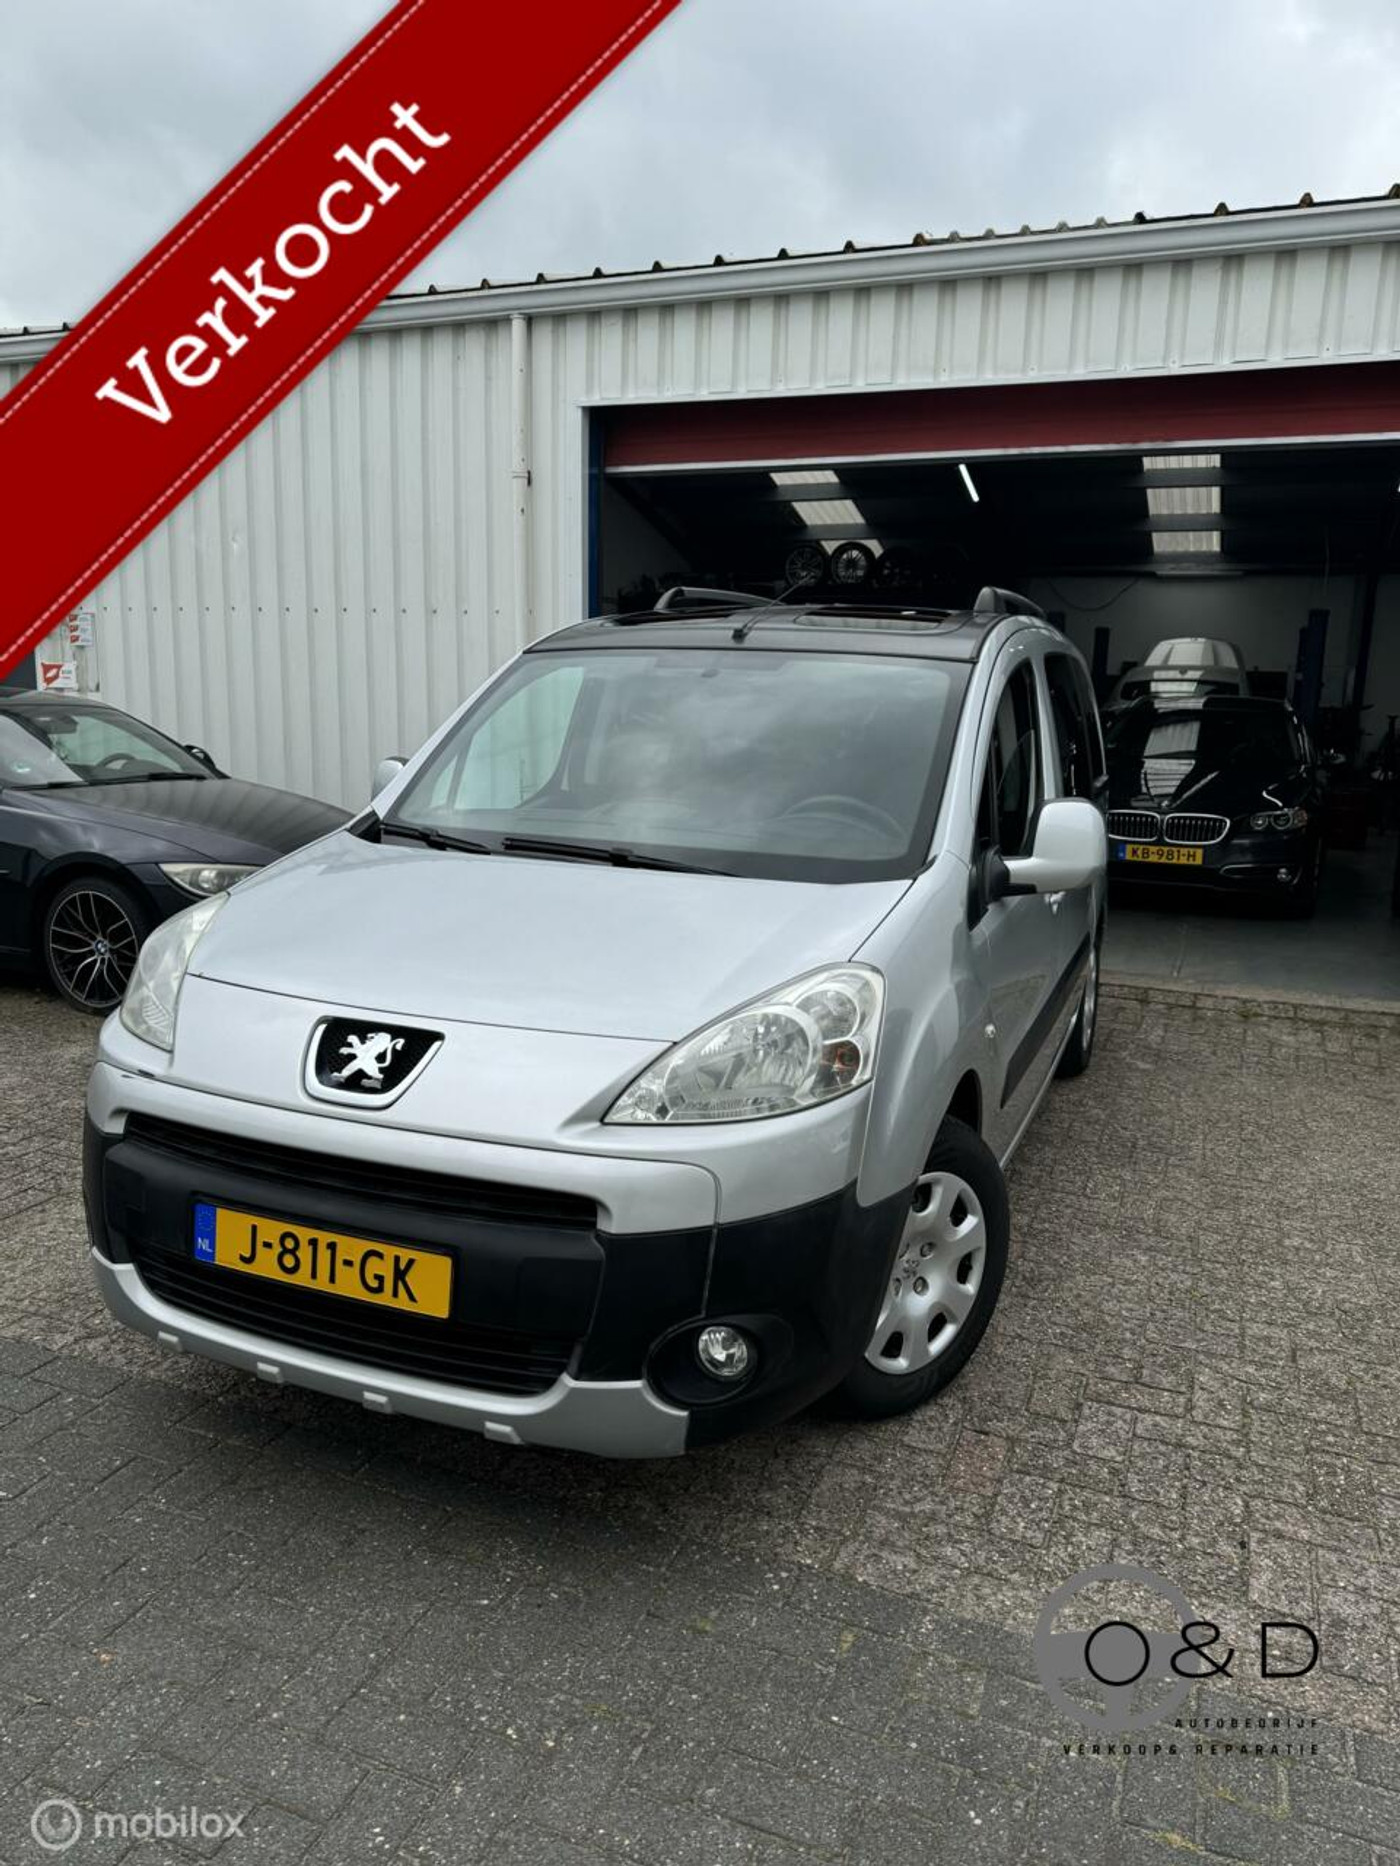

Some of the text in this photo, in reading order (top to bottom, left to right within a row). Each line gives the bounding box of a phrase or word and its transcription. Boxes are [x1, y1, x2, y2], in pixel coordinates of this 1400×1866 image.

[1130, 848, 1197, 863] KB-981-H
[197, 1224, 418, 1304] NL J-811-GK
